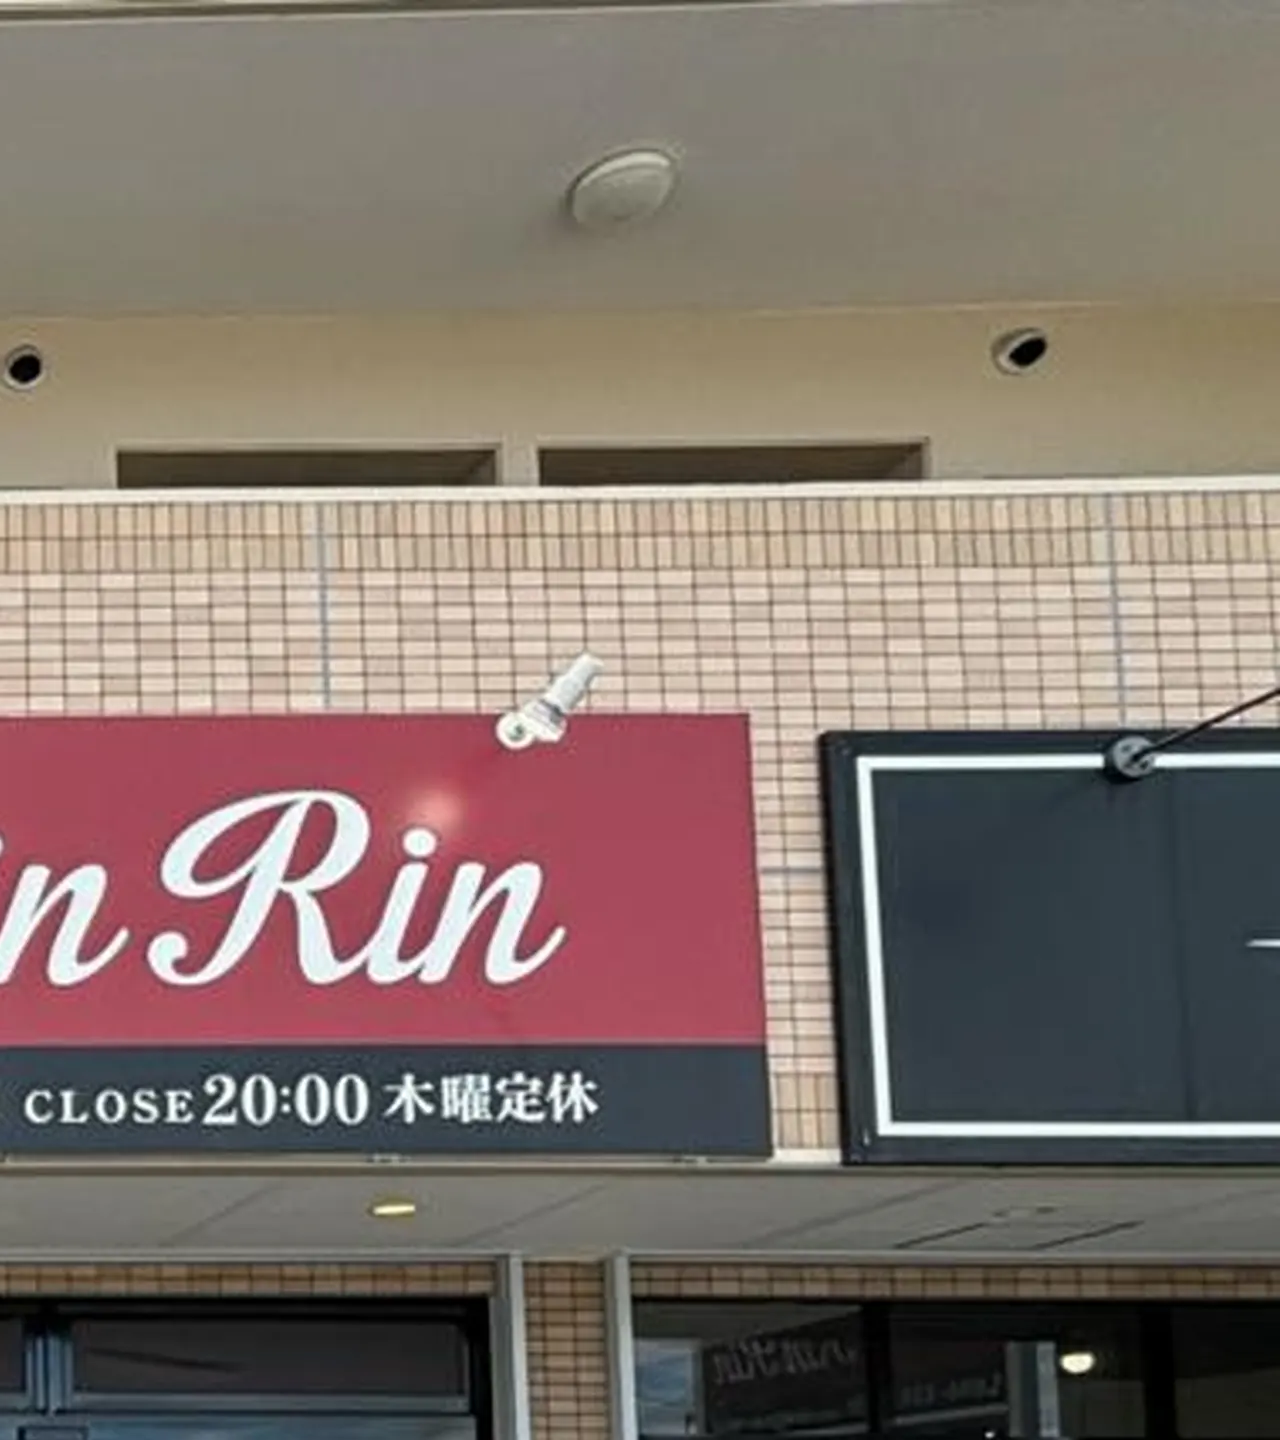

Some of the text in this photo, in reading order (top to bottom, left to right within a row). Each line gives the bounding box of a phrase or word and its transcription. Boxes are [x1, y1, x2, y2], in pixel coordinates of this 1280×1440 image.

[146, 788, 567, 986] Rin
[382, 1070, 600, 1126] 木曜定休
